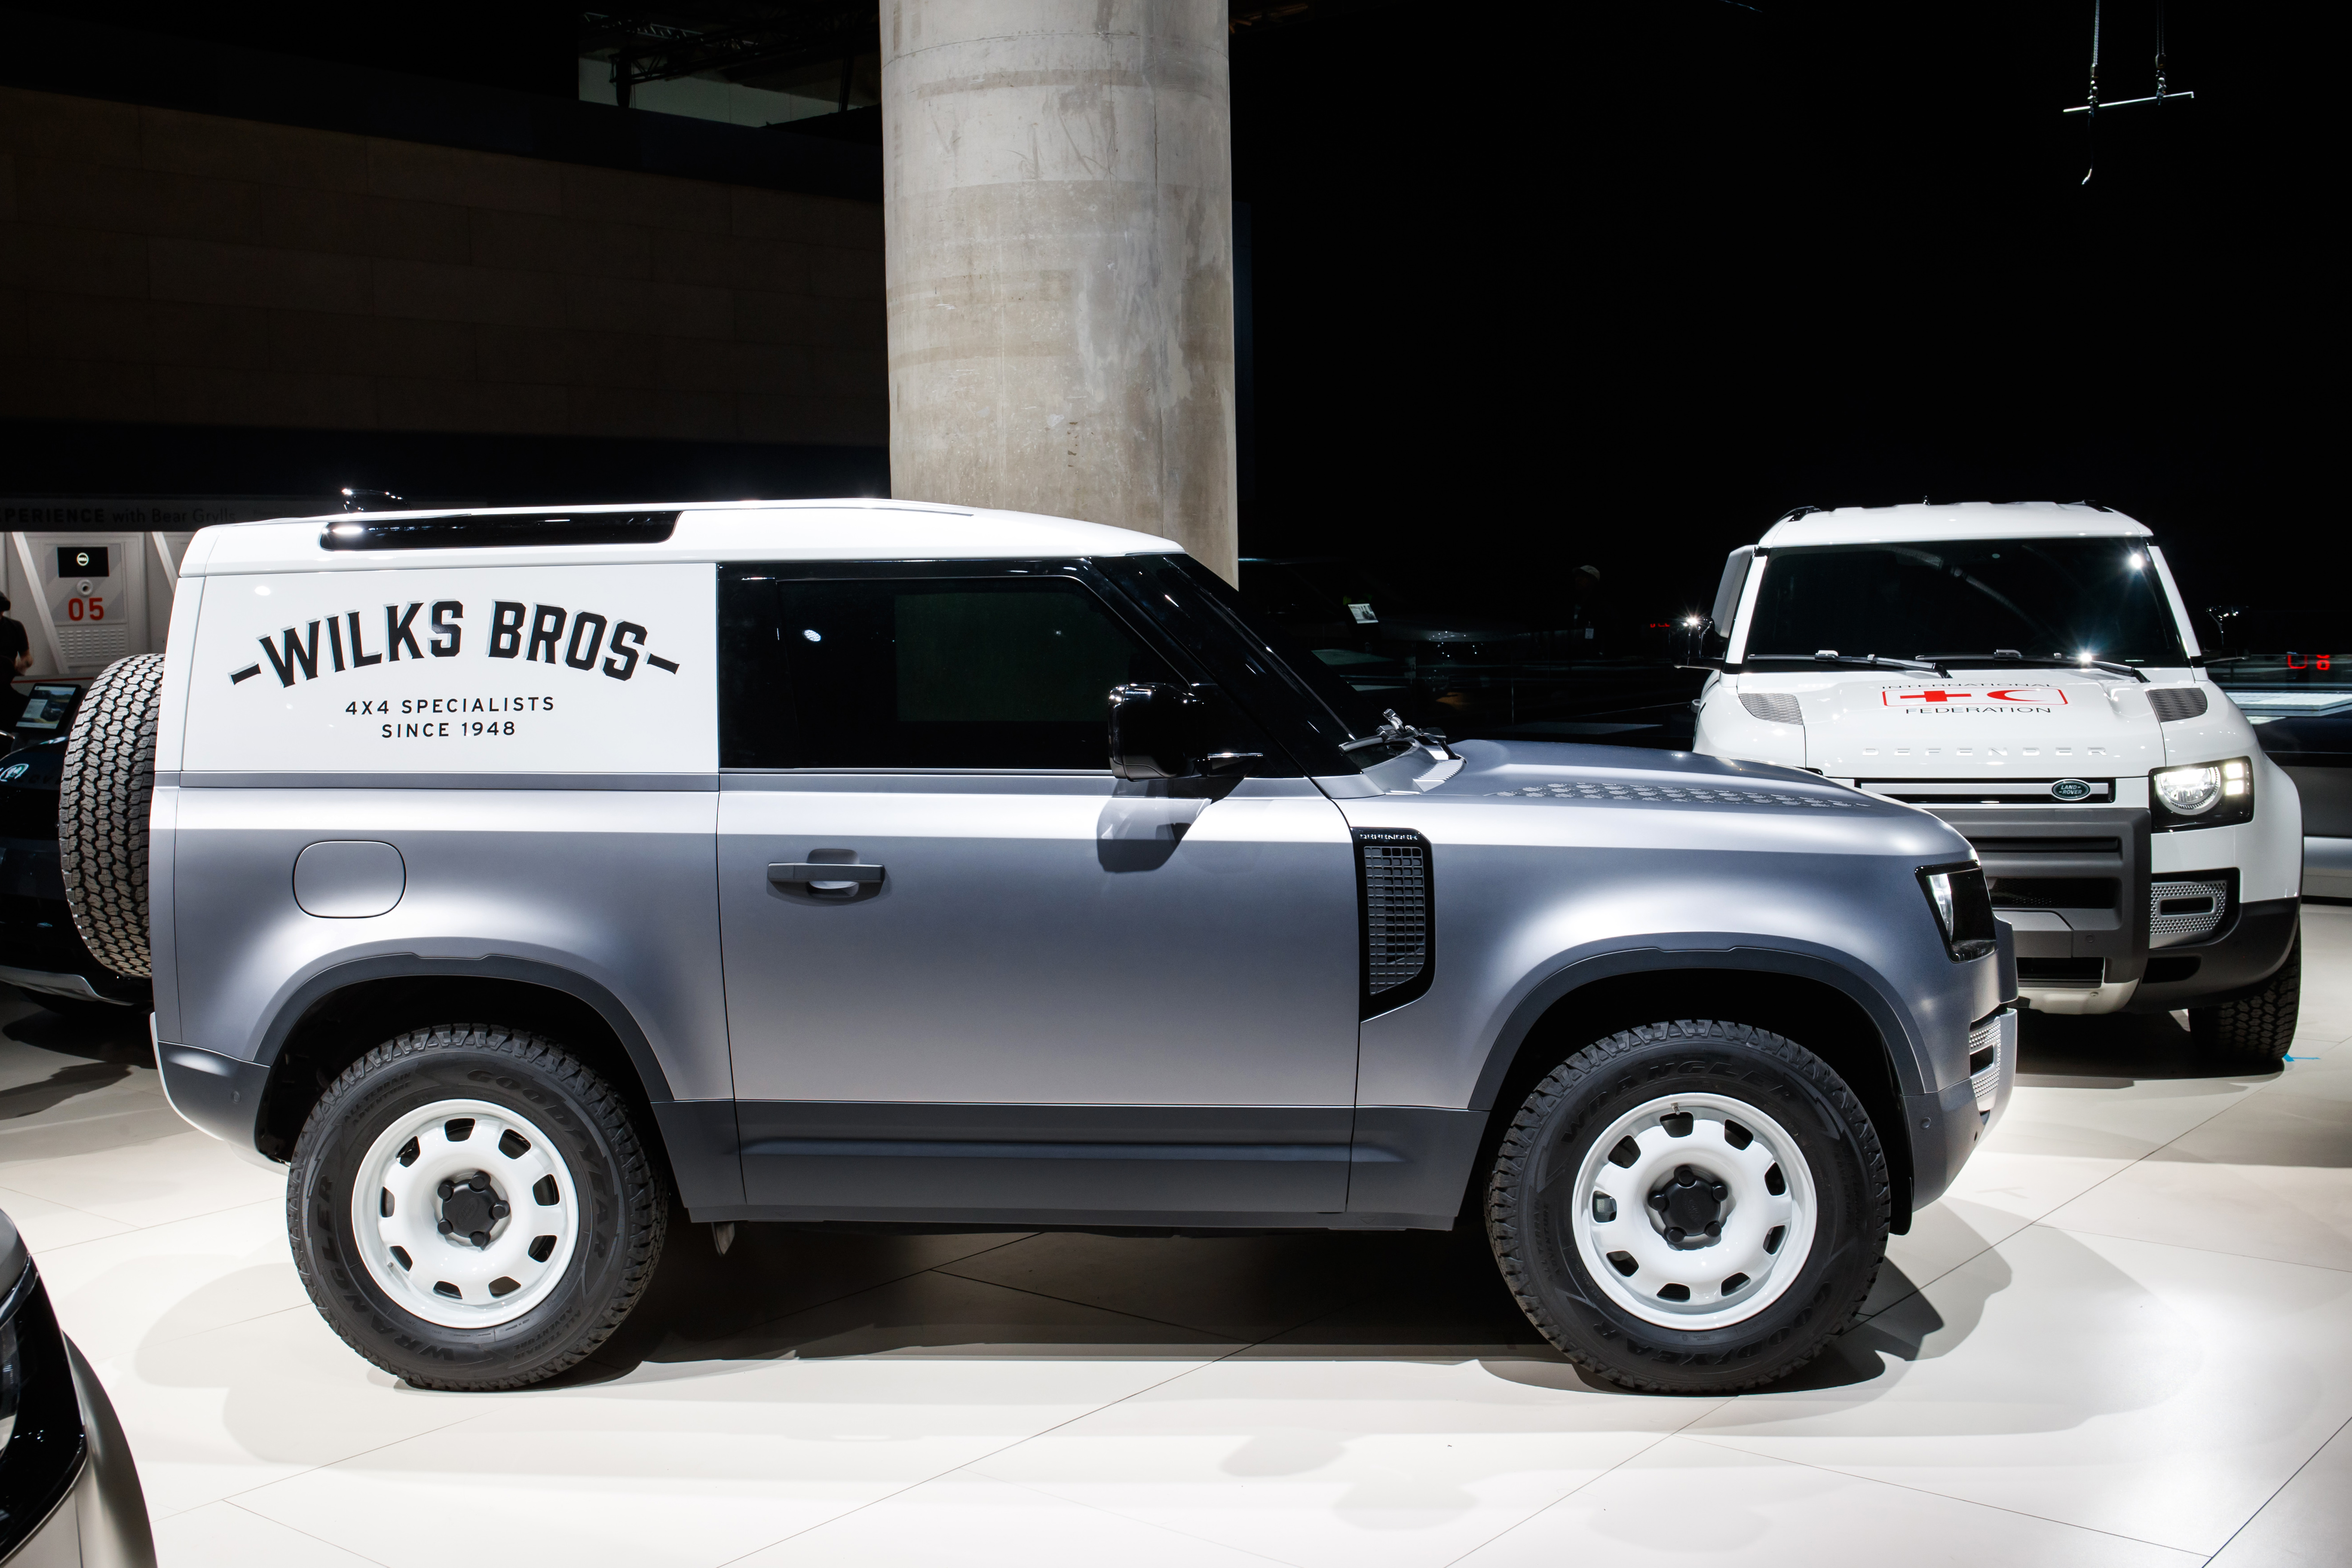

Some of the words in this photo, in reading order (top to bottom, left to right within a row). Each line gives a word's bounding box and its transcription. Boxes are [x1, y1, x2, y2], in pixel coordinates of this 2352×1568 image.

[0, 508, 104, 523] PERIENCE
[112, 508, 146, 523] with
[152, 508, 188, 523] Bear
[68, 597, 104, 622] 05
[257, 600, 463, 688] WILKS
[487, 600, 648, 682] BROS
[346, 700, 389, 715] 4X4
[401, 696, 553, 714] SPECIALISTS
[382, 723, 449, 738] SINCE
[462, 721, 514, 736] 1948
[1862, 747, 2107, 756] DEFENDER
[467, 1069, 608, 1259] GOODYEAR
[317, 1175, 455, 1361] WRANGLER
[1593, 1281, 1832, 1366] GOODYEAR
